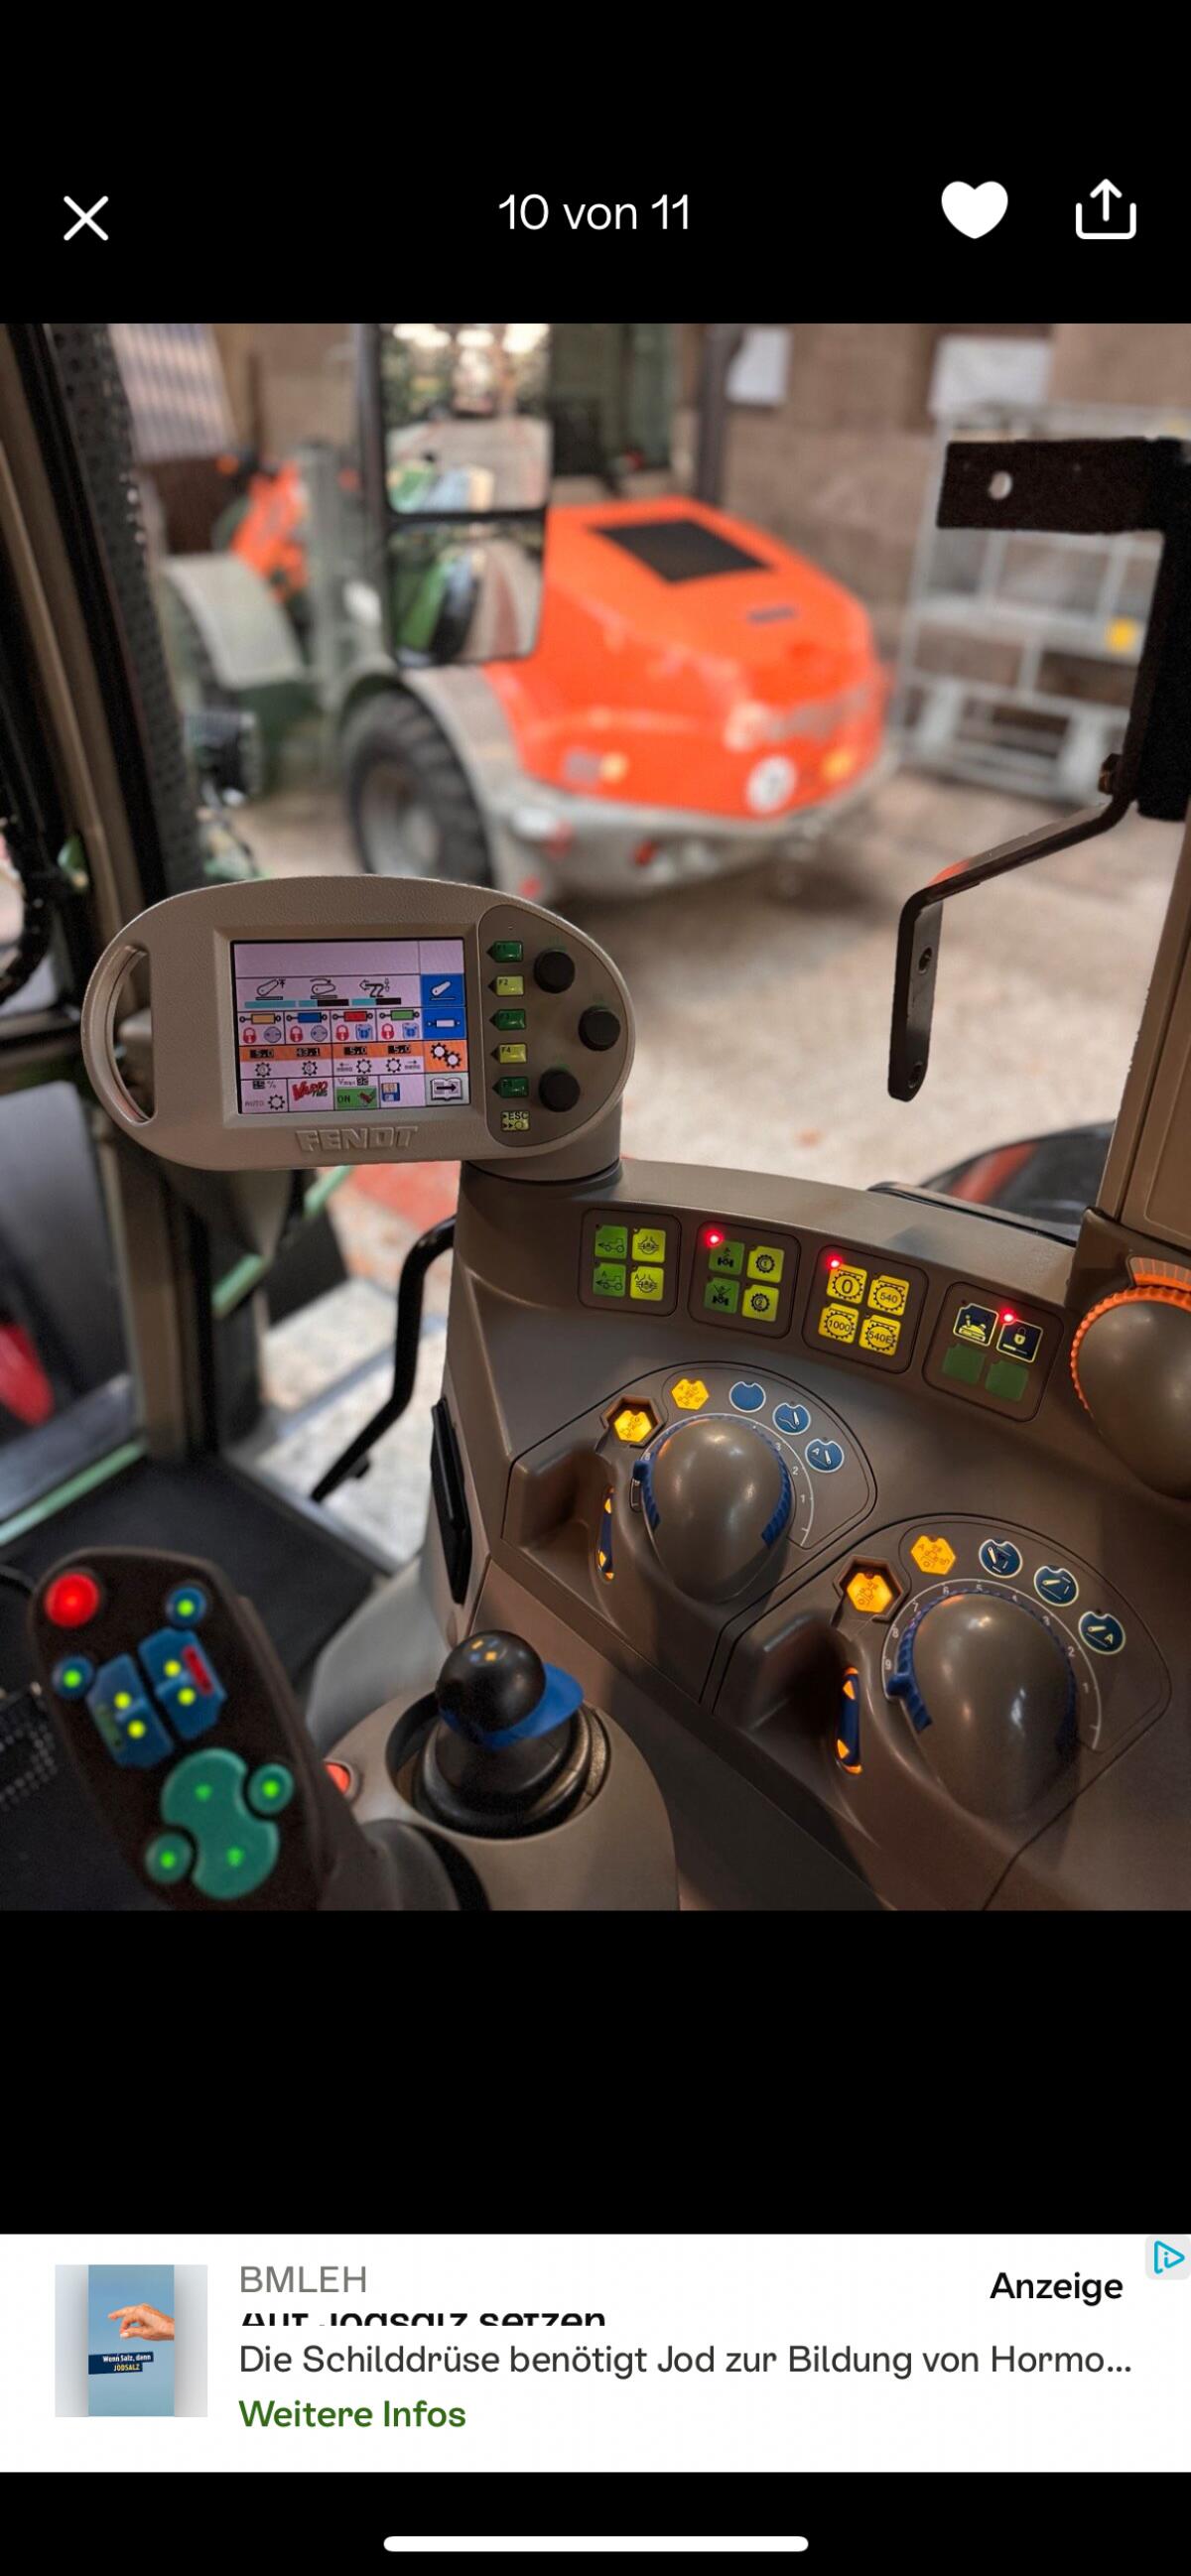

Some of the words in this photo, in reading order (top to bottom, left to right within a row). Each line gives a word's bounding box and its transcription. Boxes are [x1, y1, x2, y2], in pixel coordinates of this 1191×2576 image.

[337, 1095, 351, 1103] ON
[508, 1111, 529, 1120] ESC
[296, 1126, 418, 1151] FENDT
[842, 1279, 854, 1294] 0
[880, 1291, 898, 1304] 540
[829, 1319, 851, 1333] 1000
[867, 1331, 893, 1344] 540E
[792, 1466, 799, 1476] 2
[912, 1602, 919, 1612] 7
[891, 1626, 899, 1638] 8
[1067, 1645, 1076, 1657] 2
[884, 1658, 892, 1670] 9
